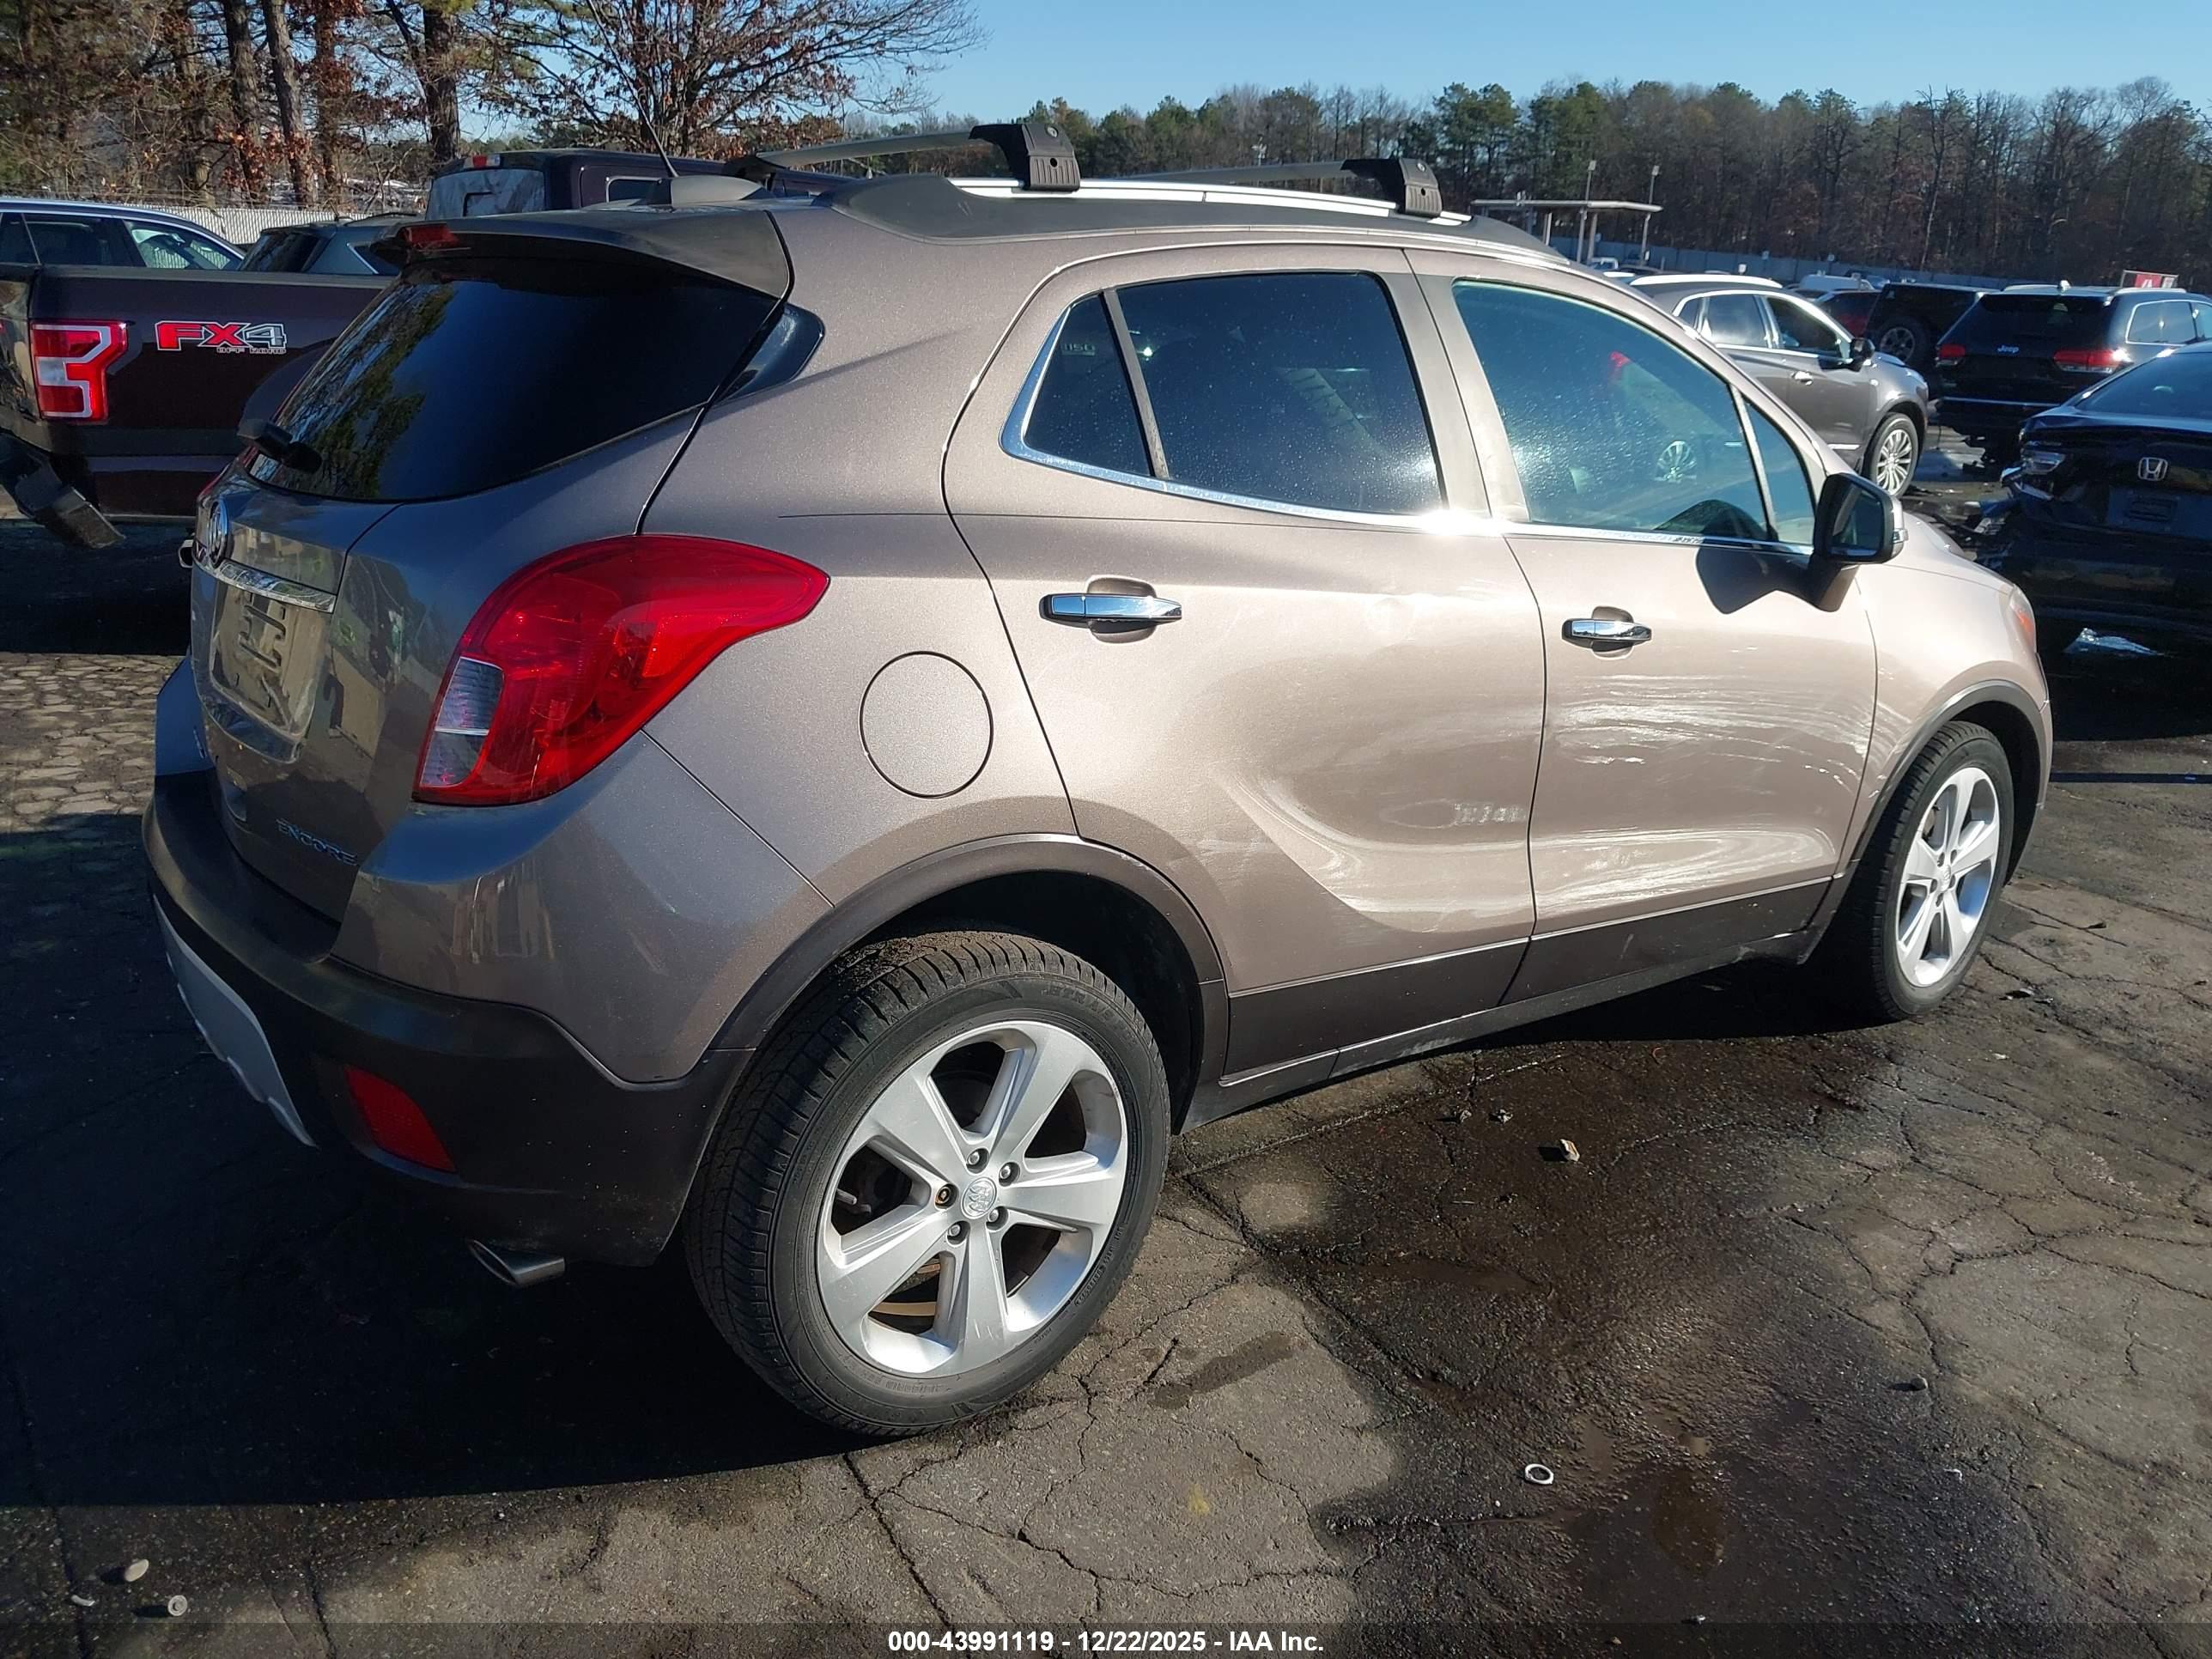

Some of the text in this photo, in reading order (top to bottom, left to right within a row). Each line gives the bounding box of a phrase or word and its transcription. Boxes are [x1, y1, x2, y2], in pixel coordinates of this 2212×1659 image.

[155, 320, 287, 351] FX4
[1997, 344, 2020, 354] Jeep
[276, 817, 358, 866] ENCORE
